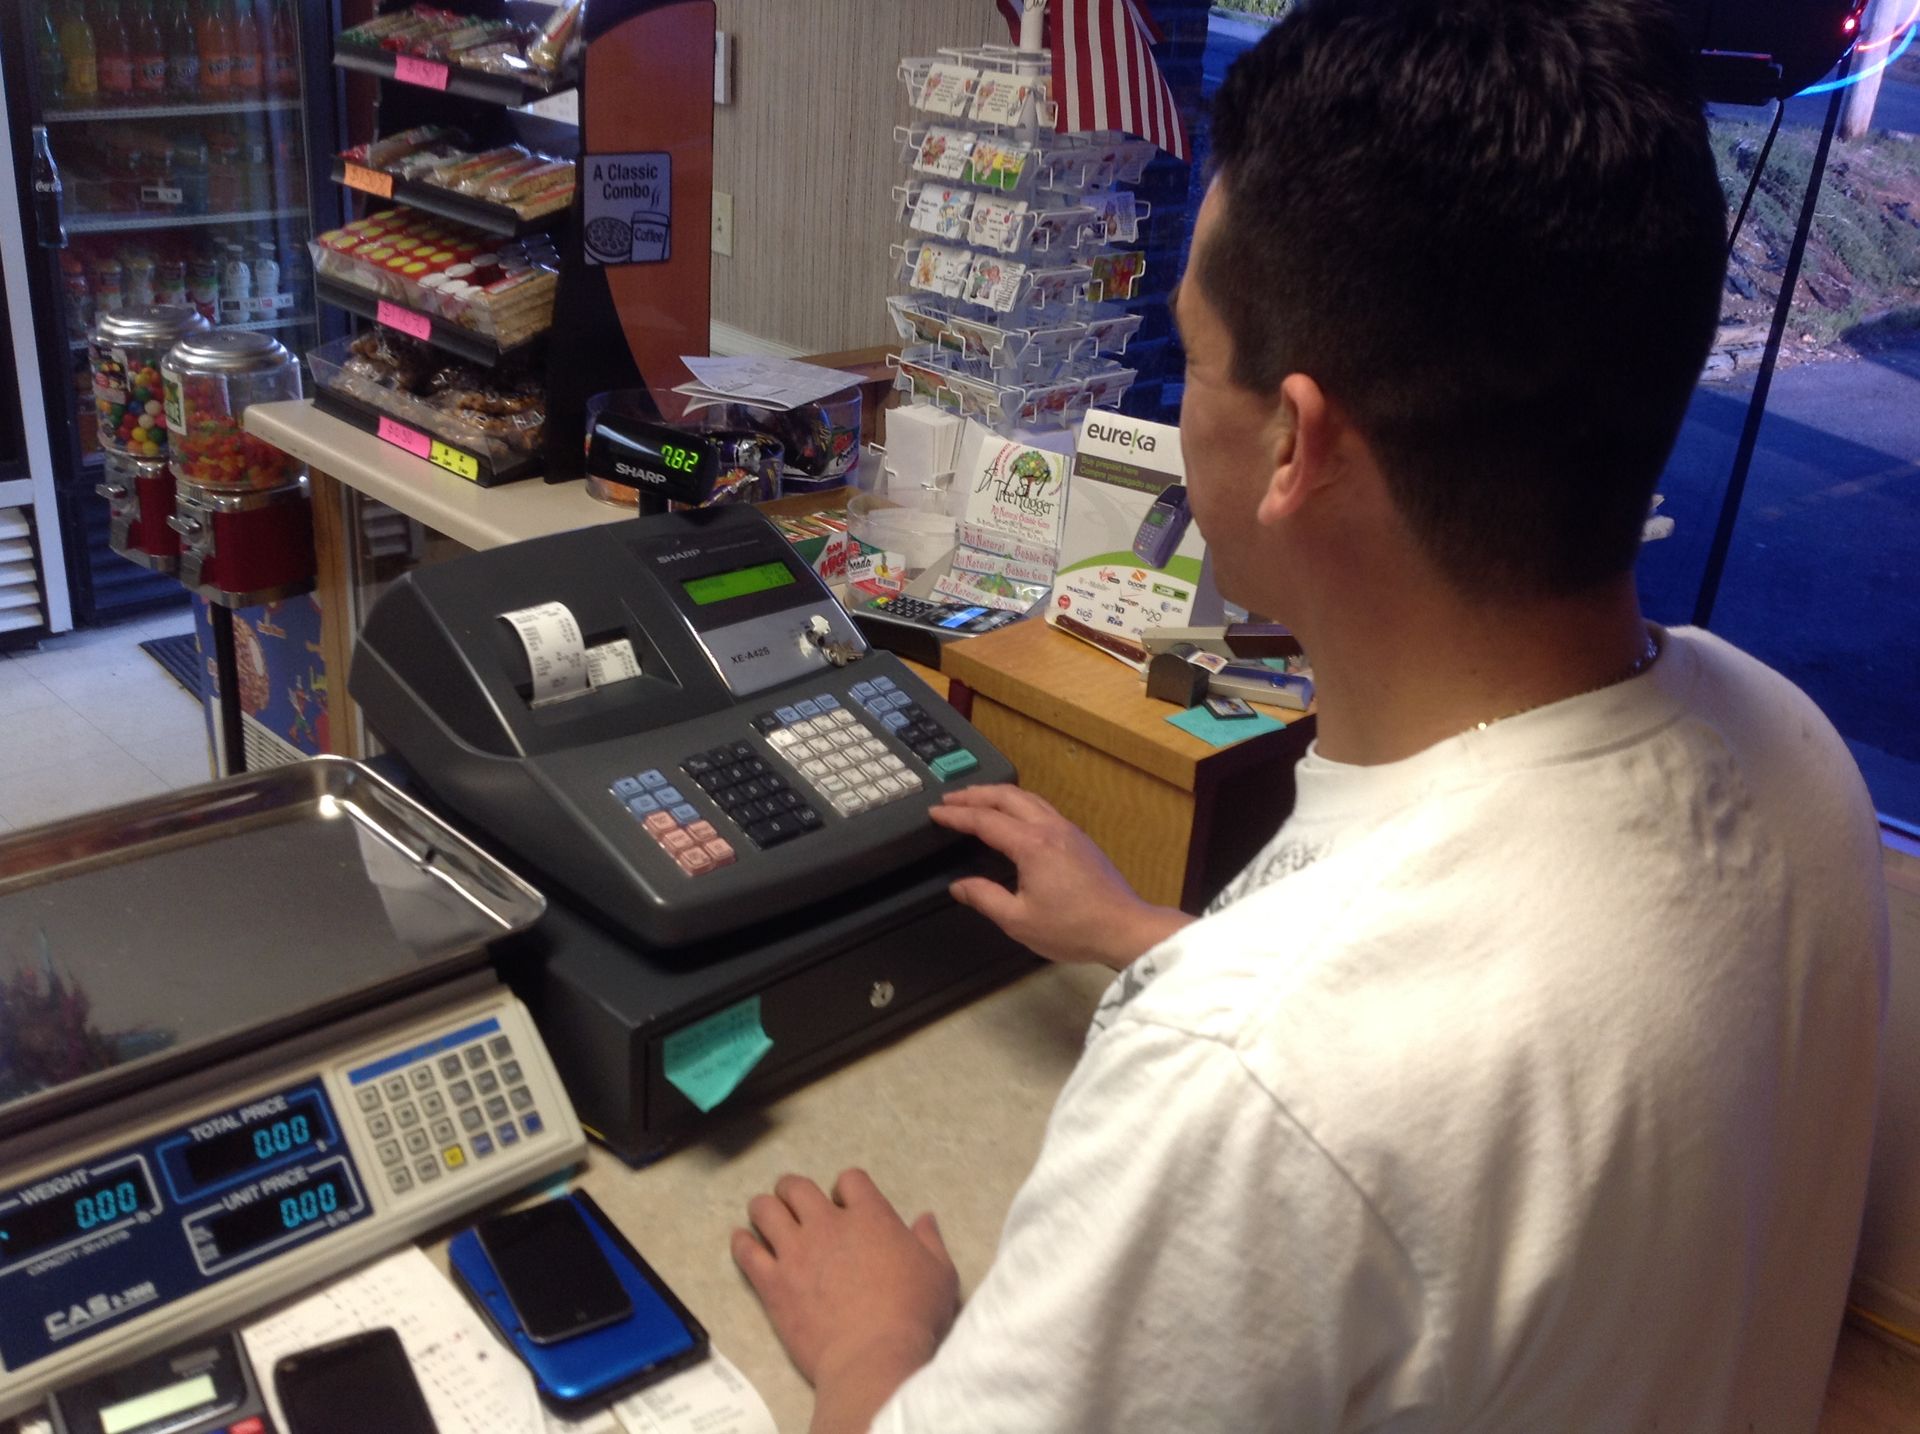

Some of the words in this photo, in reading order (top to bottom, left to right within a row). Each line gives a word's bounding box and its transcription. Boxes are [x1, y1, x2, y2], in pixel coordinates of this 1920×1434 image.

[593, 165, 603, 181] A
[608, 163, 658, 180] Classic
[602, 182, 650, 200] Combo
[1087, 423, 1156, 454] eureka
[615, 462, 667, 485] SHARP
[656, 549, 700, 564] SHARP
[189, 1115, 242, 1142] TOTAL
[238, 1095, 289, 1123] PRICE
[19, 1168, 89, 1205] WEIGHT
[222, 1184, 261, 1211] UNIT
[259, 1166, 310, 1196] PRICE
